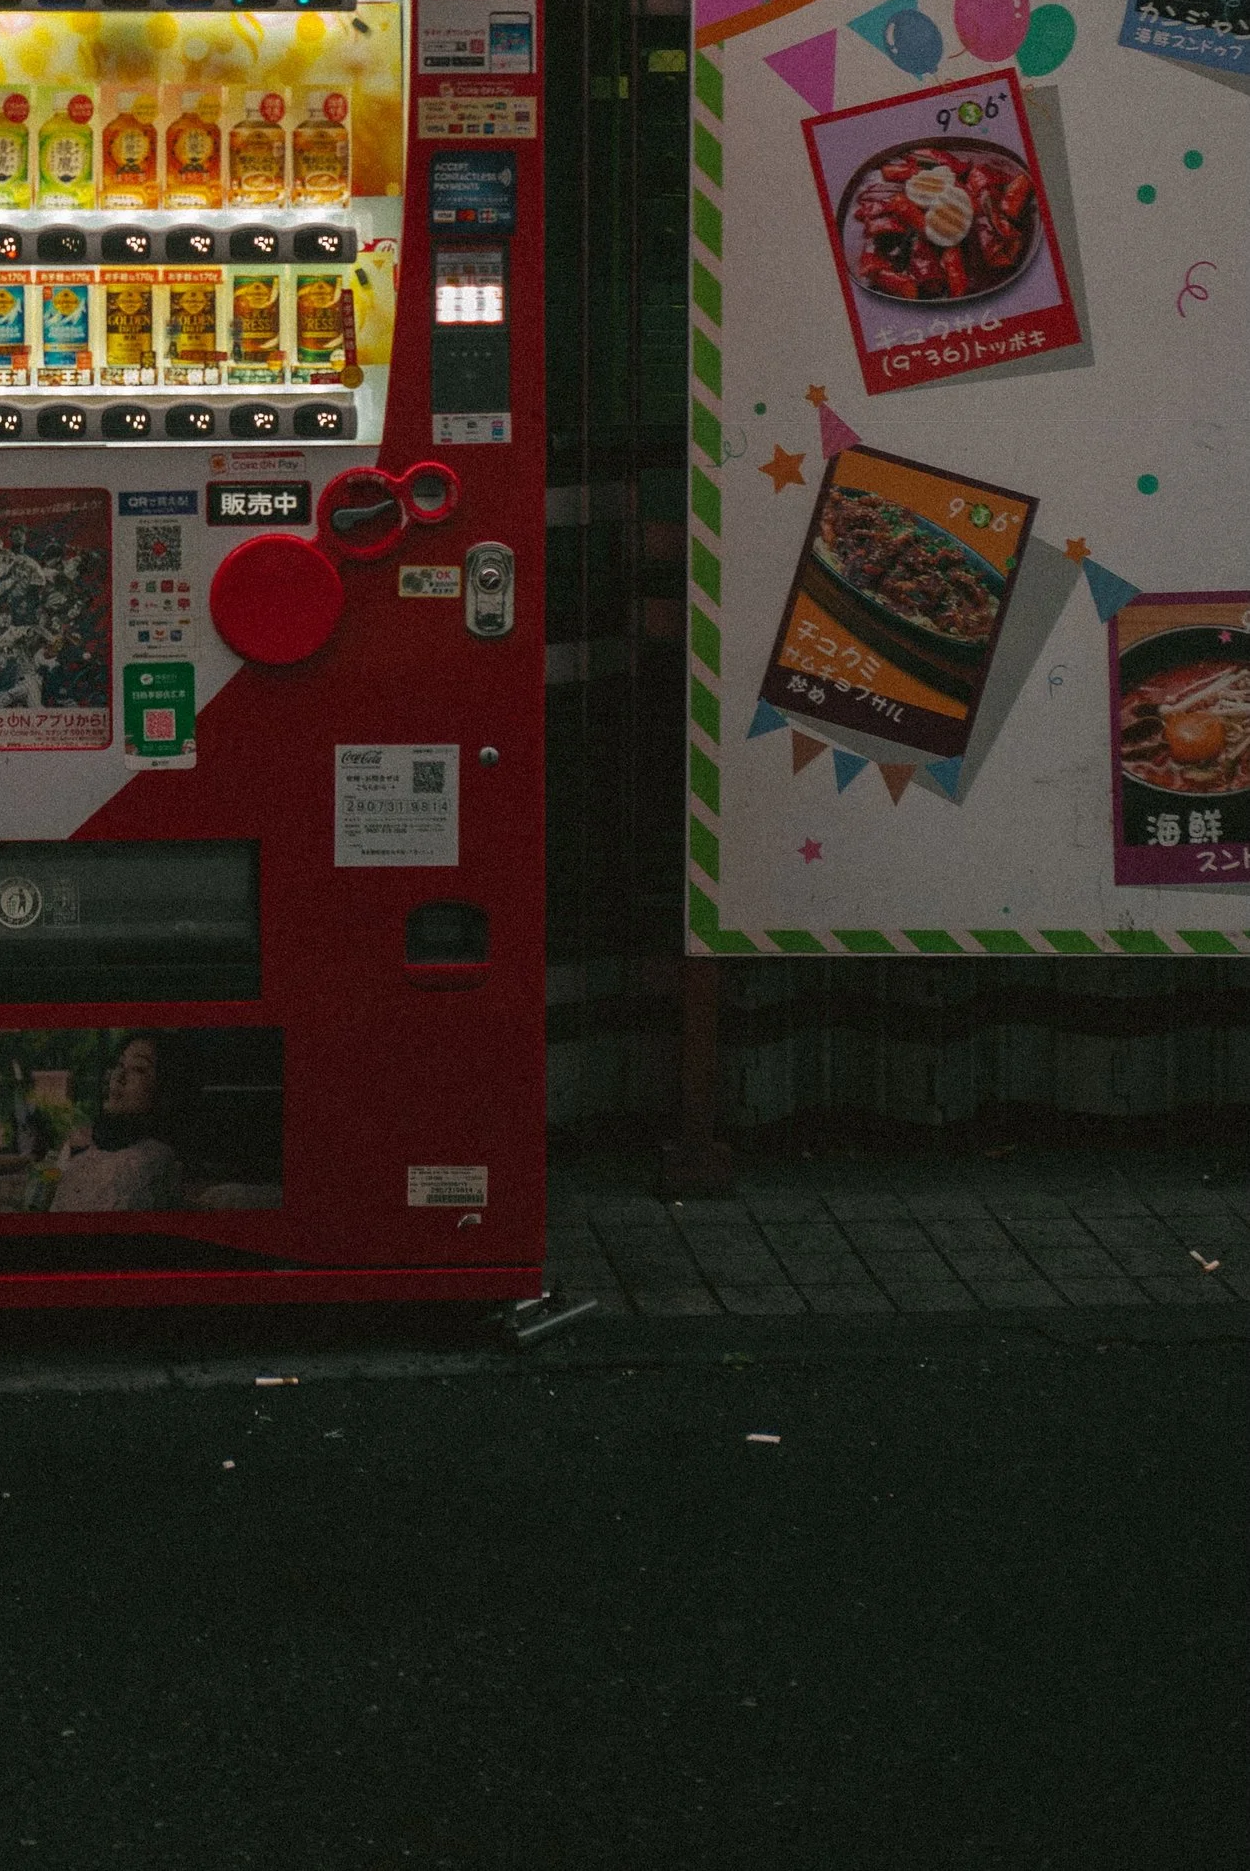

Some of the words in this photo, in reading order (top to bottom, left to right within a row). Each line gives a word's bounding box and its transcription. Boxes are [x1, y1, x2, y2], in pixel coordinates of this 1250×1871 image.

[220, 492, 299, 516] 販売中
[786, 674, 826, 706] 炒め
[340, 749, 383, 766] Coca-Cola
[1146, 807, 1224, 848] 海鮮
